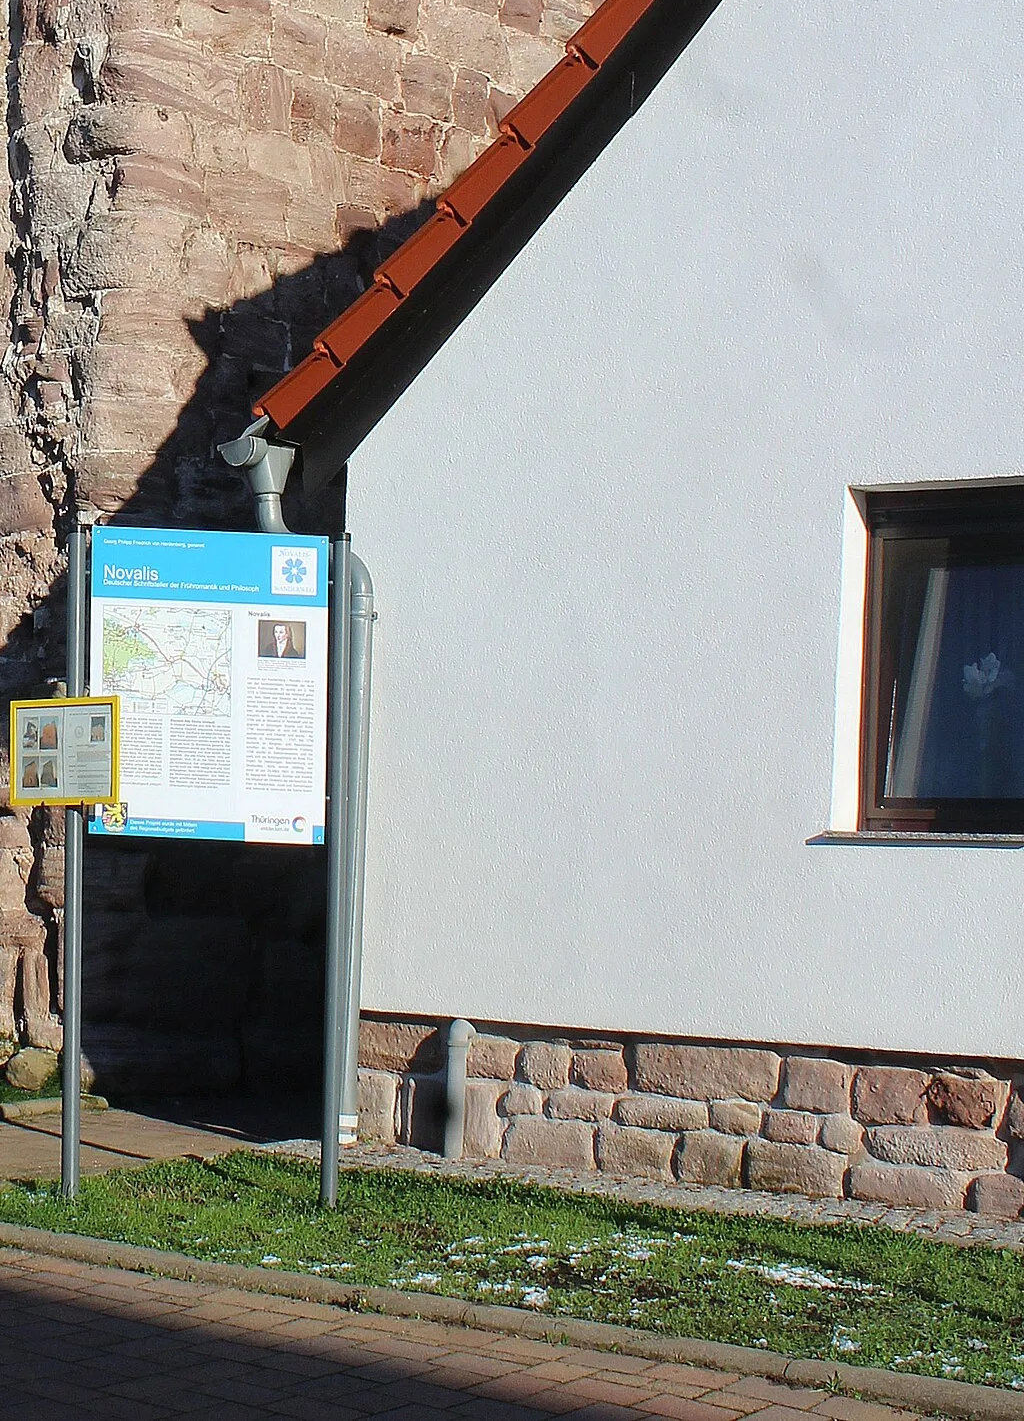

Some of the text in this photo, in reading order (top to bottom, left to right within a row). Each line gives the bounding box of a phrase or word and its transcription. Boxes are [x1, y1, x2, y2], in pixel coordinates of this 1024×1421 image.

[103, 564, 159, 581] Novalis
[103, 579, 132, 587] Deutscher
[133, 580, 168, 588] Schriftsteller
[180, 582, 218, 590] Frühromantik
[231, 585, 260, 593] Philosoph
[251, 815, 290, 826] Thüringen
